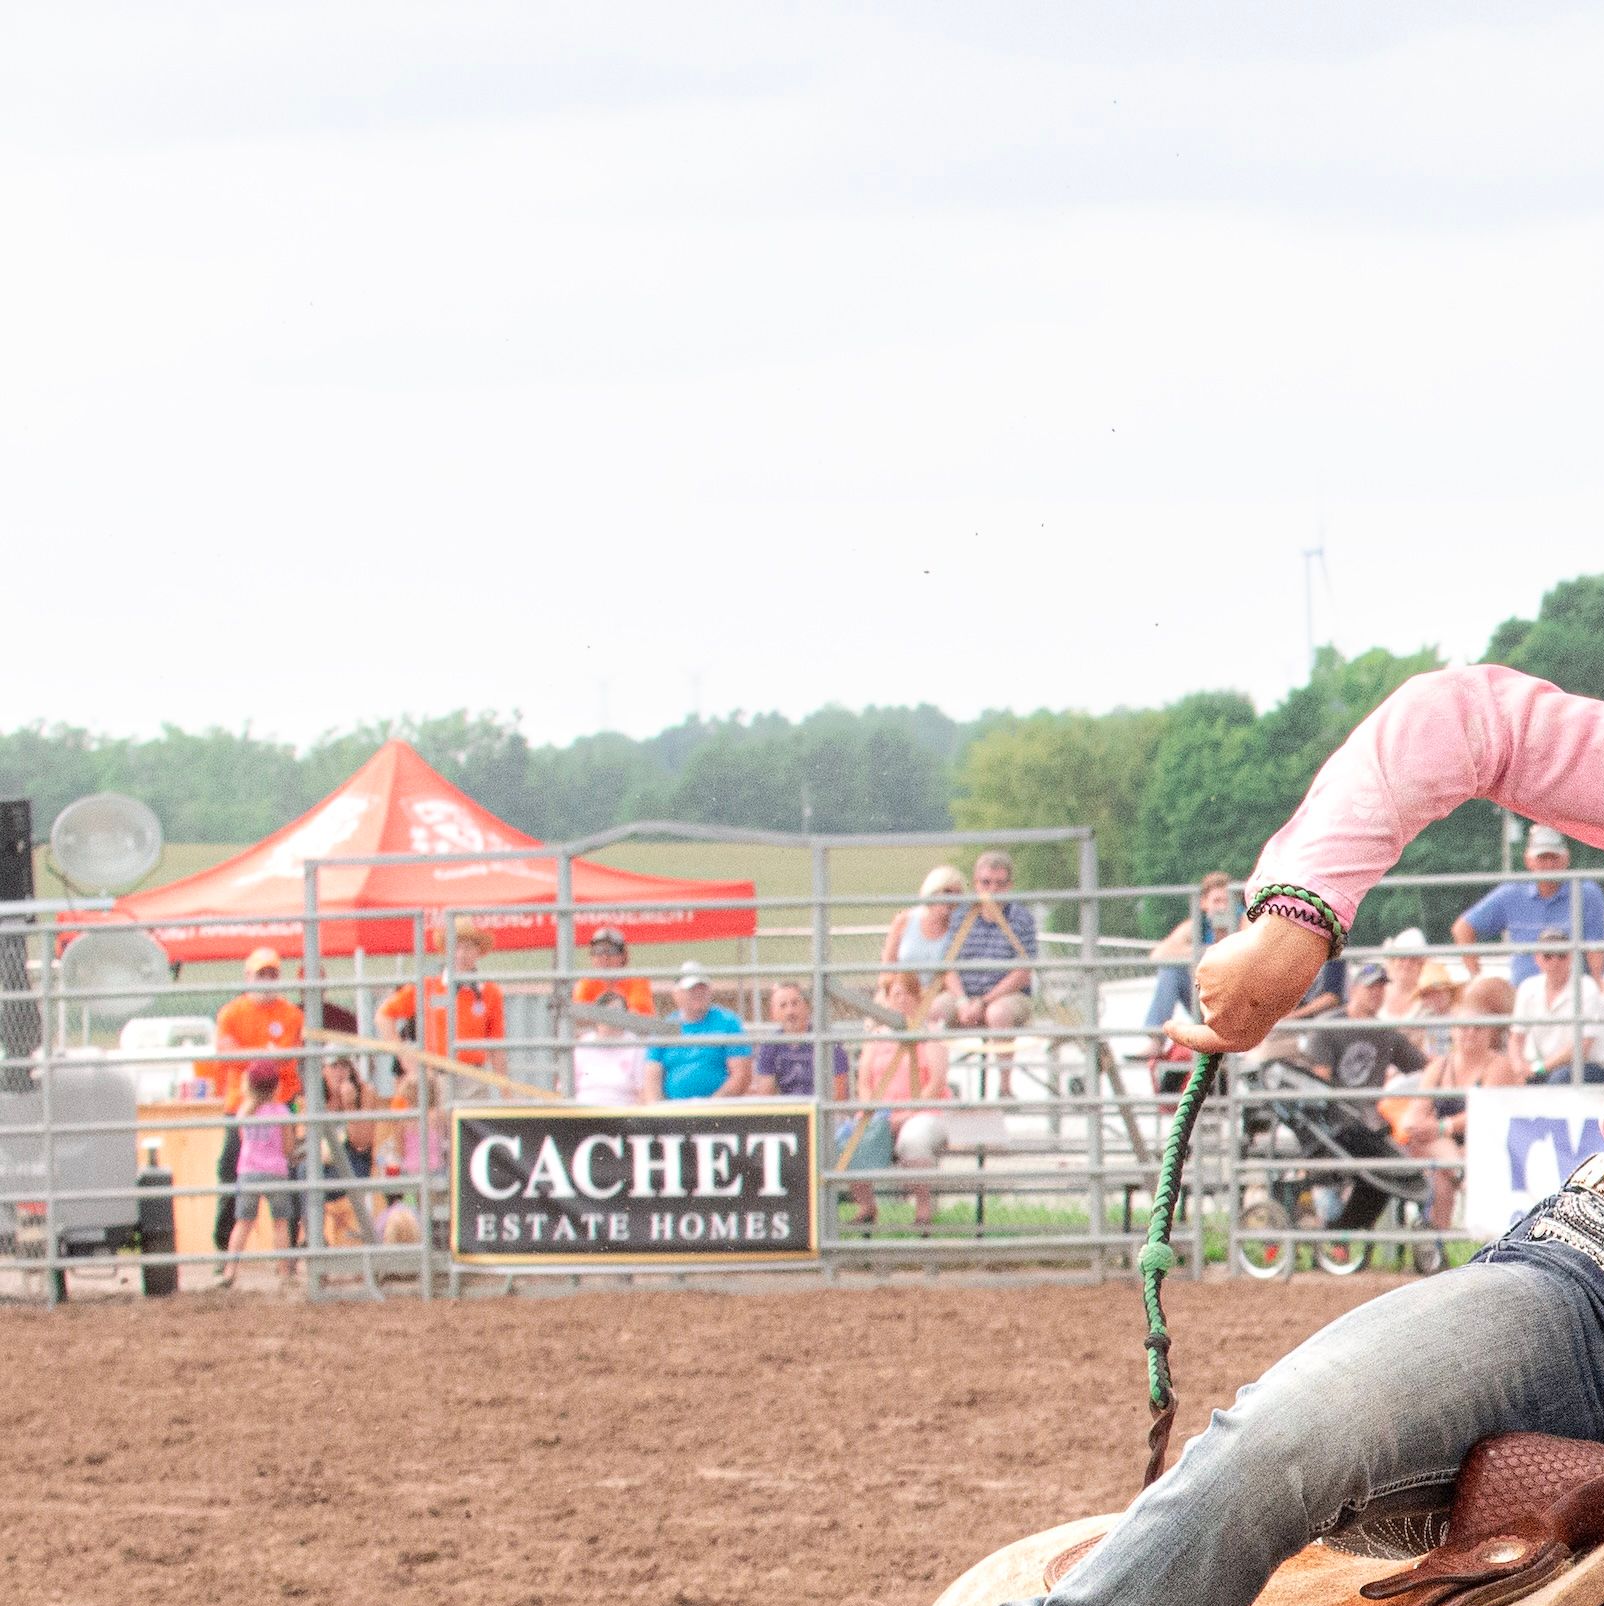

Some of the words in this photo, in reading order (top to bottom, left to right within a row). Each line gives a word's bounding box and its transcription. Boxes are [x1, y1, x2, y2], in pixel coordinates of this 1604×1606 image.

[469, 1132, 799, 1201] CACHET
[475, 1212, 631, 1242] ESTATE
[649, 1211, 791, 1241] HOMES
